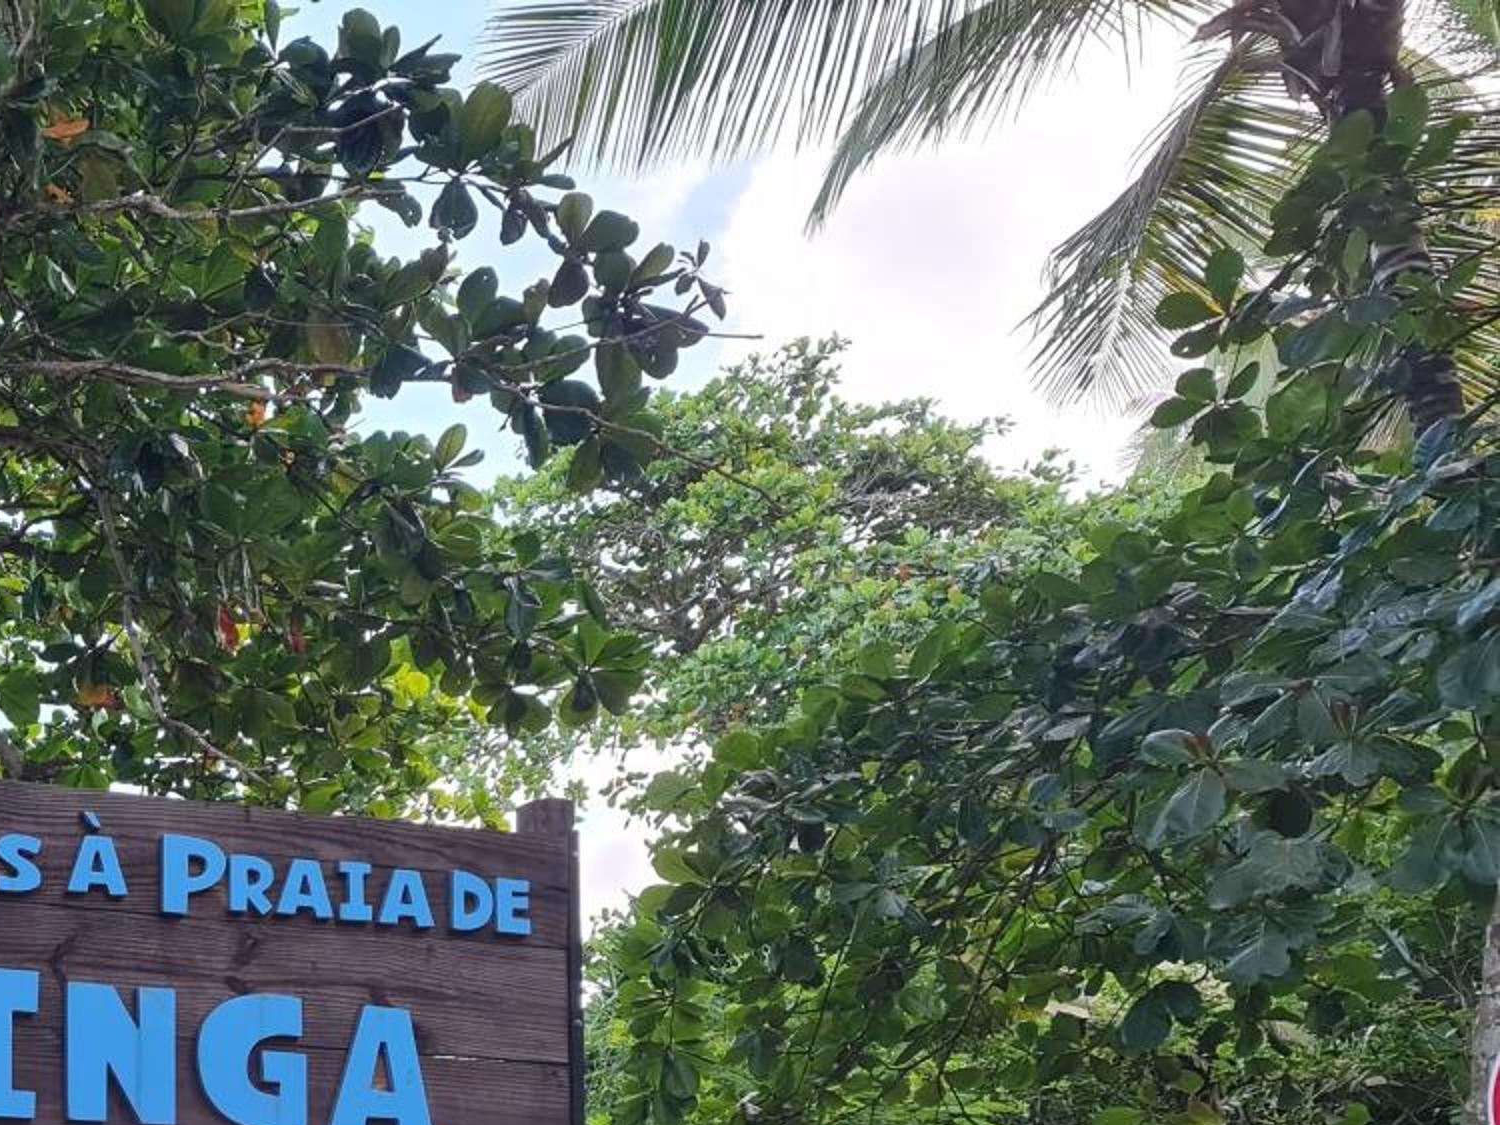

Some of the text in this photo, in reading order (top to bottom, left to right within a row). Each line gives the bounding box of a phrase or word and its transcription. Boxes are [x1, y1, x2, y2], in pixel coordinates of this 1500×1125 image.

[67, 811, 128, 897] À
[161, 833, 436, 928] PRAIA
[451, 869, 533, 936] DE
